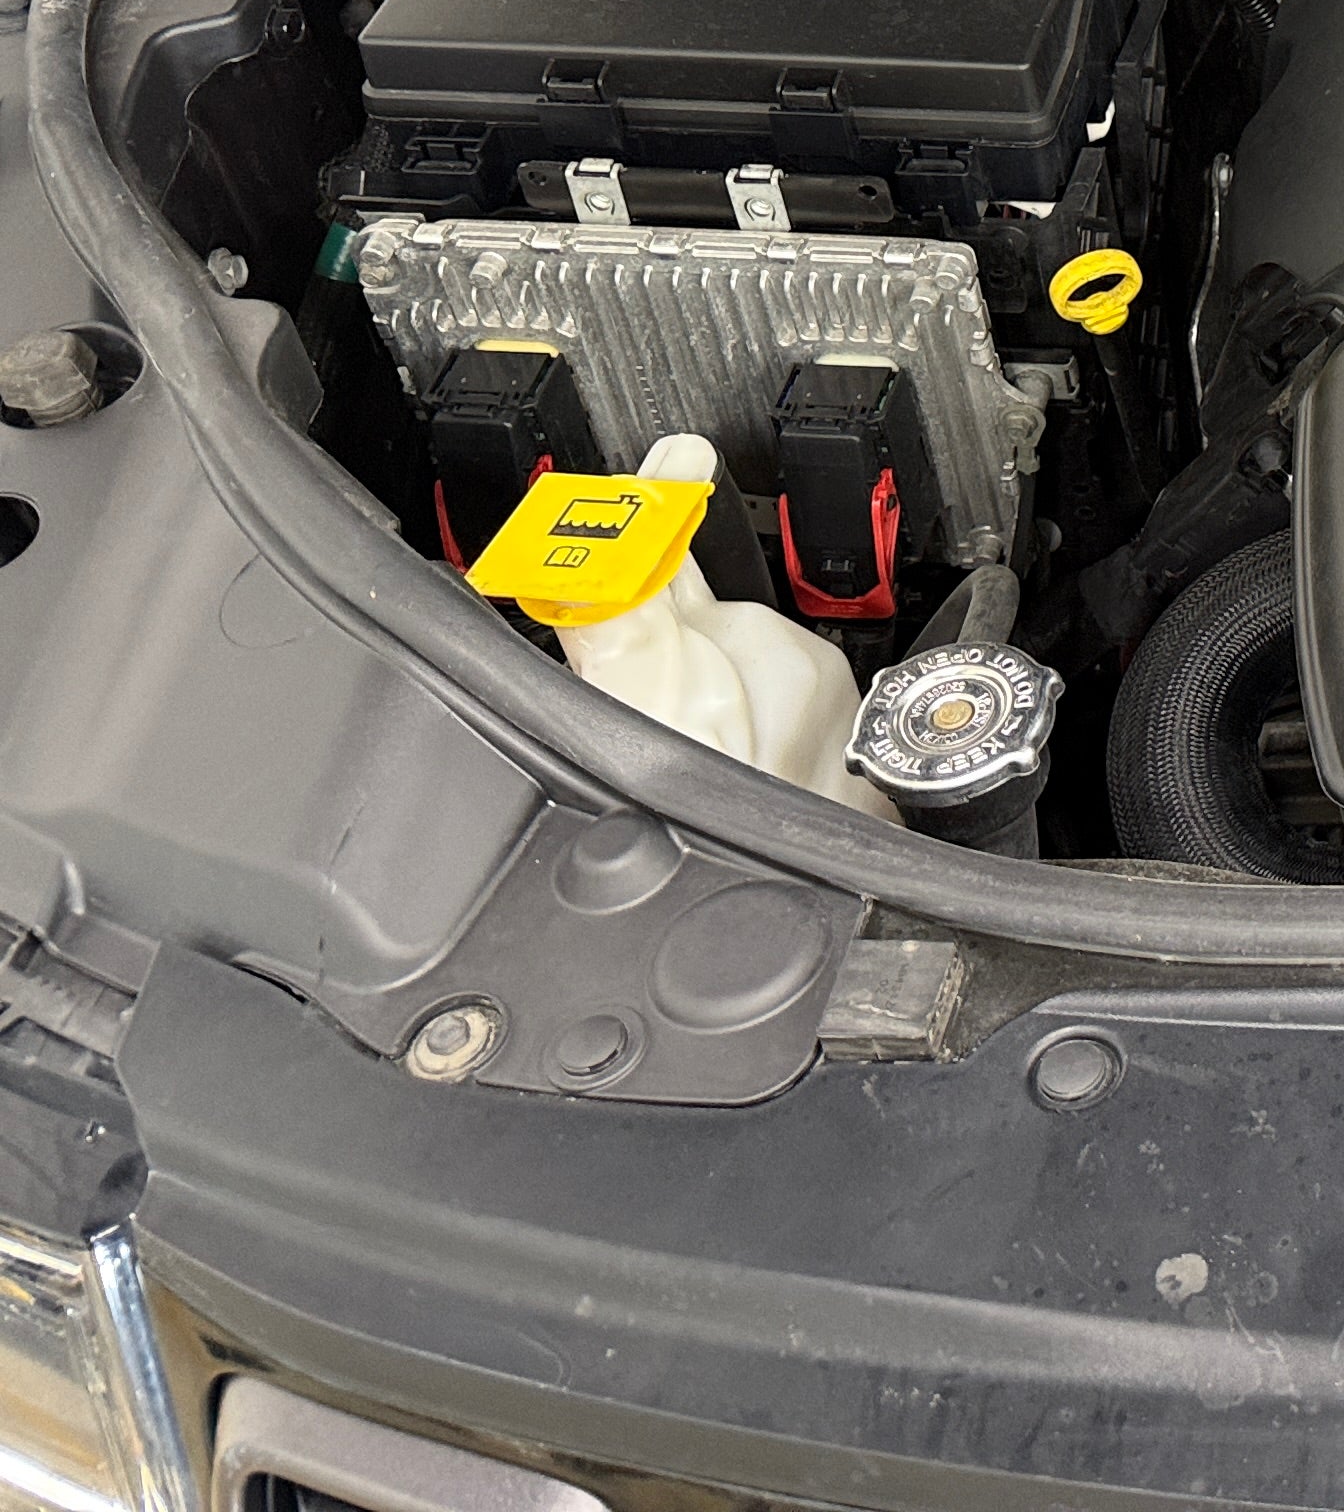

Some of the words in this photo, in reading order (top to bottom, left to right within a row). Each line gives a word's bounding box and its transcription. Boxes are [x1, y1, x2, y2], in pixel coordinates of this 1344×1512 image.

[917, 648, 984, 675] OPEN
[875, 672, 917, 708] HOT
[869, 739, 923, 776] TIGHT
[936, 737, 1006, 775] KEEP
